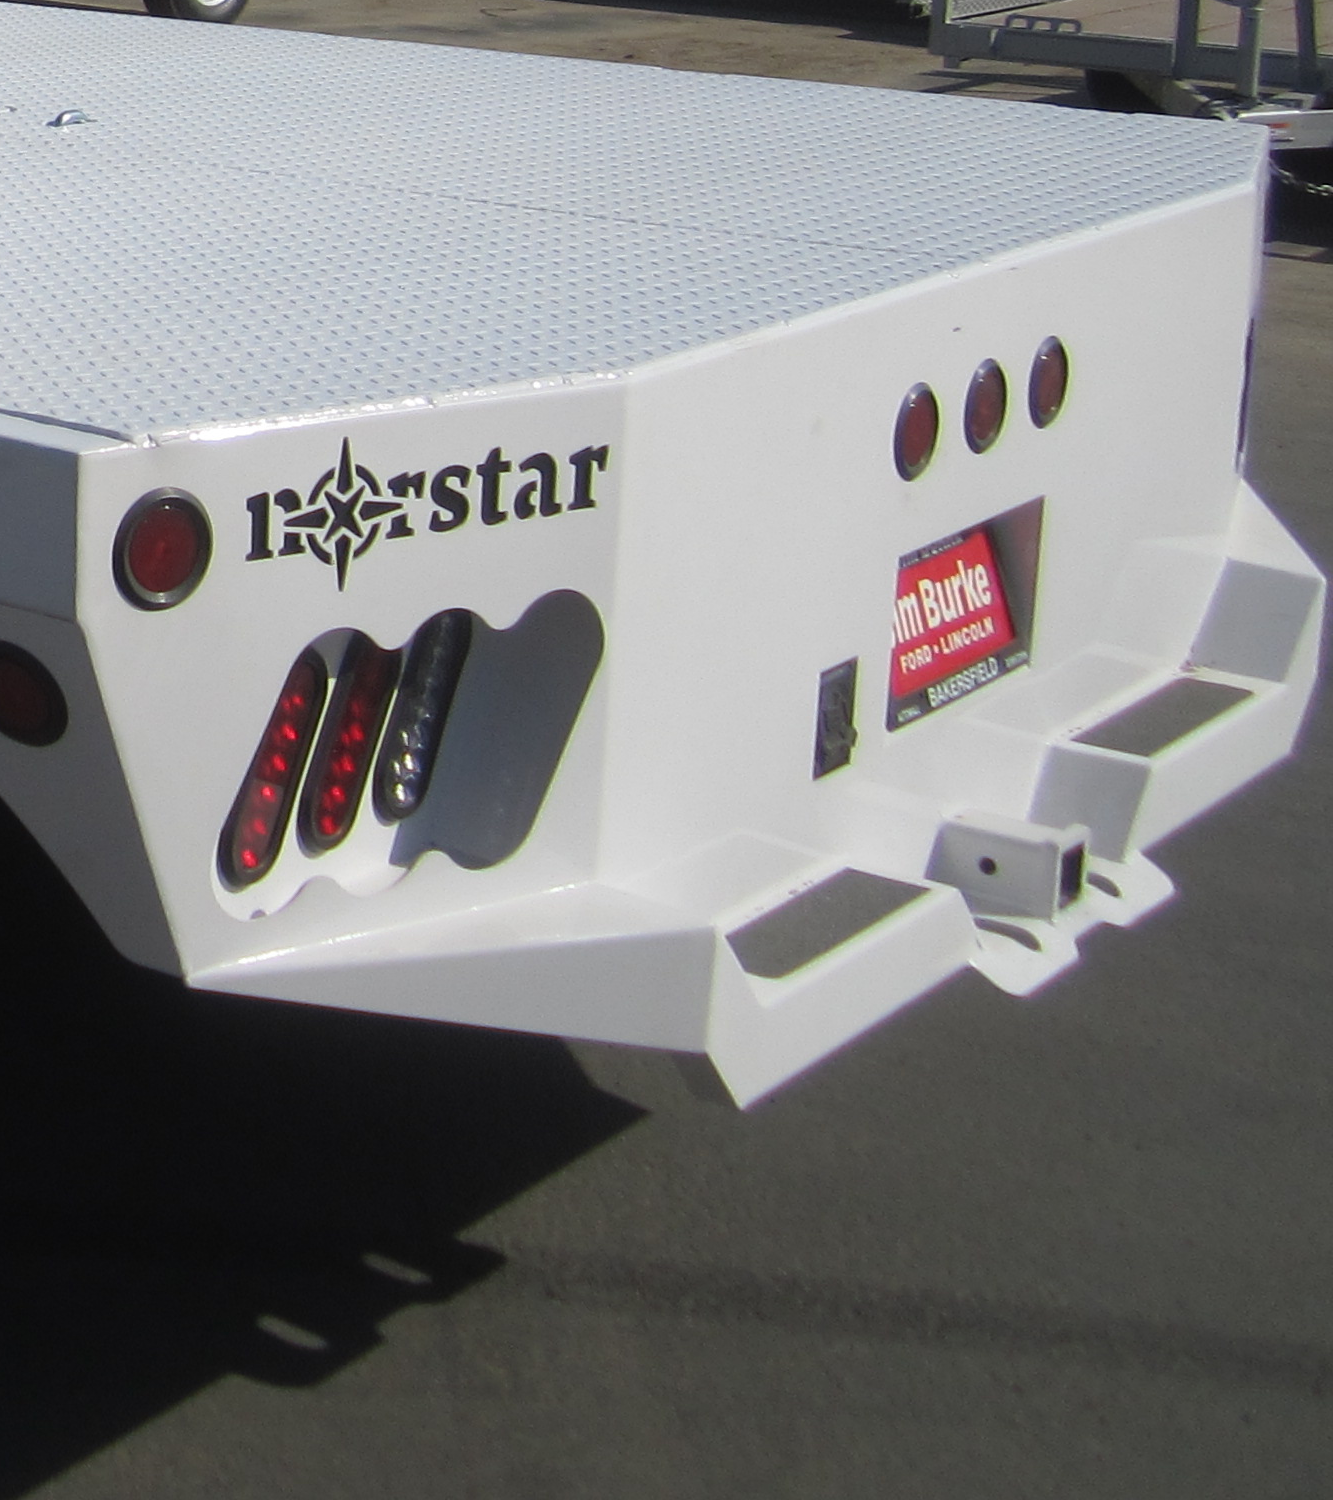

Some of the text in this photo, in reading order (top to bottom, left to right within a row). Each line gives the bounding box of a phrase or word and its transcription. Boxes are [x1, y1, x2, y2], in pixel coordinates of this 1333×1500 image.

[892, 560, 992, 647] im Burke
[899, 616, 995, 674] FORD LINCOLN
[927, 657, 998, 708] BAKERSFIELD
